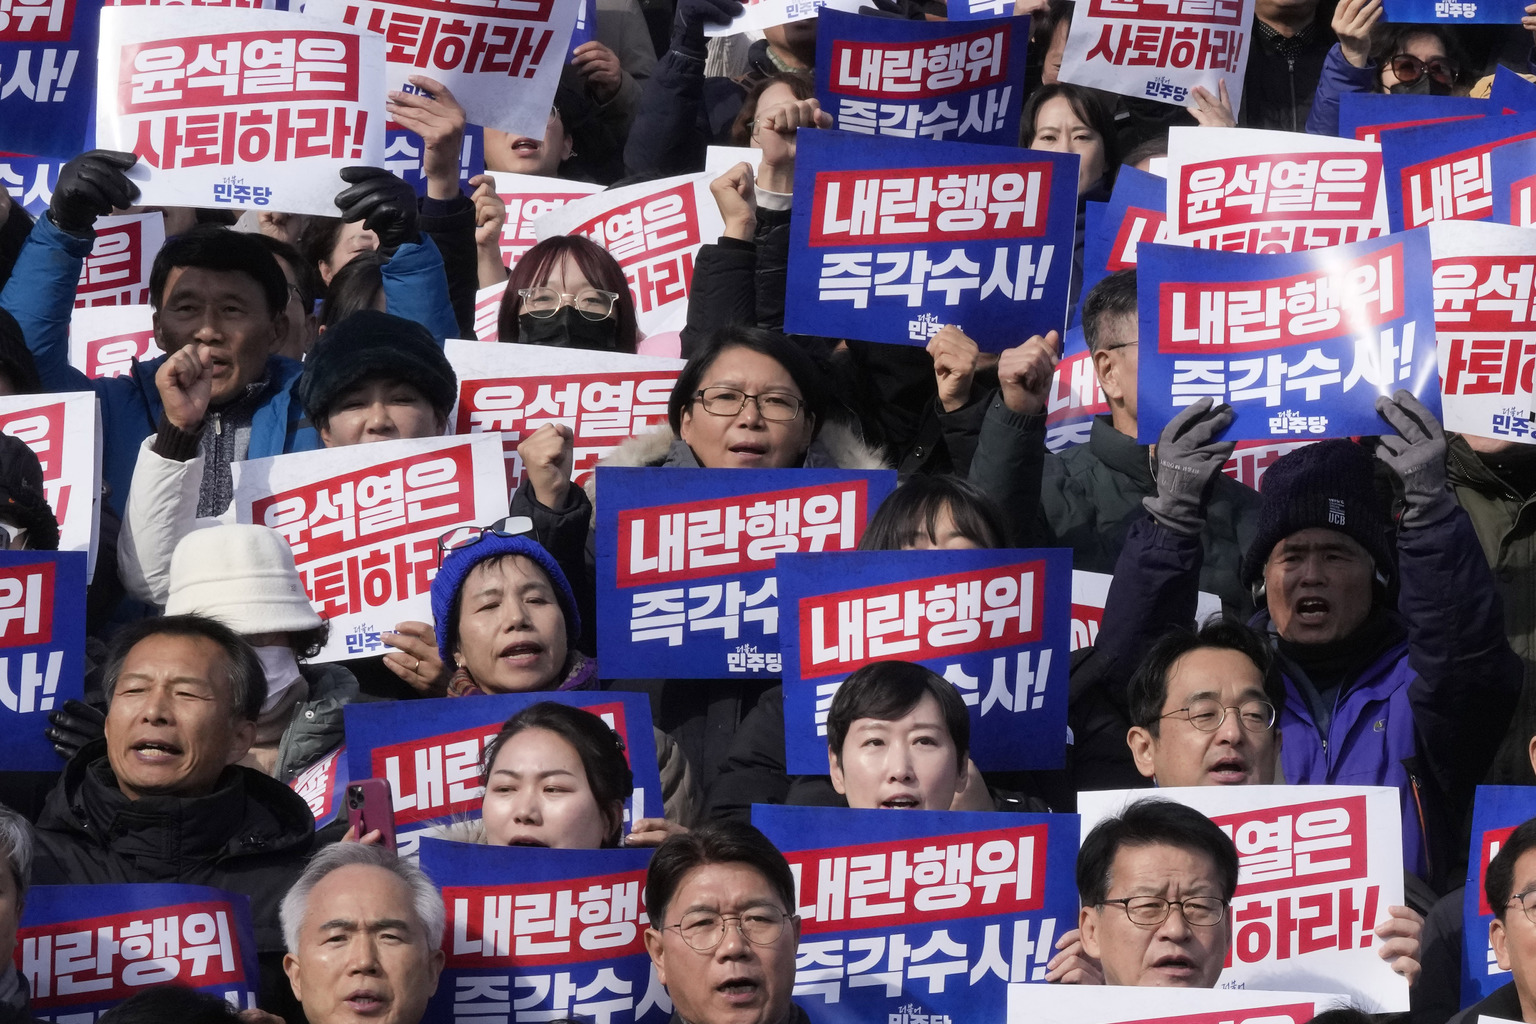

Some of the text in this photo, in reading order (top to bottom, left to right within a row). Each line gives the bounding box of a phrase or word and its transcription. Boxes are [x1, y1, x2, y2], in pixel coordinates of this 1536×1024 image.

[1436, 2, 1477, 19] 민주당
[131, 34, 347, 104] 윤석열은
[838, 32, 1003, 94] 내란행위
[1087, 25, 1240, 74] 사퇴하라!
[1145, 80, 1189, 102] 민주당
[135, 107, 368, 170] 사퇴하라!
[213, 183, 272, 205] 민주당
[223, 176, 244, 185] 더불어
[821, 170, 1043, 237] 내란행위
[1186, 158, 1366, 224] 윤석열은
[819, 245, 1054, 309] 즉각수사!
[1171, 254, 1395, 346] 내란행위
[1171, 321, 1414, 408] 즉각수사!
[471, 377, 682, 441] 윤석열은
[1268, 414, 1328, 435] 민주당
[1278, 410, 1299, 421] 더불어
[262, 456, 461, 552] 윤석열은
[630, 491, 856, 575] 내란행위
[1328, 512, 1346, 526] UCB
[810, 571, 1035, 666] 내란행위
[1235, 808, 1352, 880] 열은
[793, 835, 1035, 923] 내란행위
[453, 875, 648, 958] 내란행
[1224, 885, 1380, 969] 하라!
[22, 911, 235, 999] 내란행위
[793, 919, 1058, 1004] 즉각수사!
